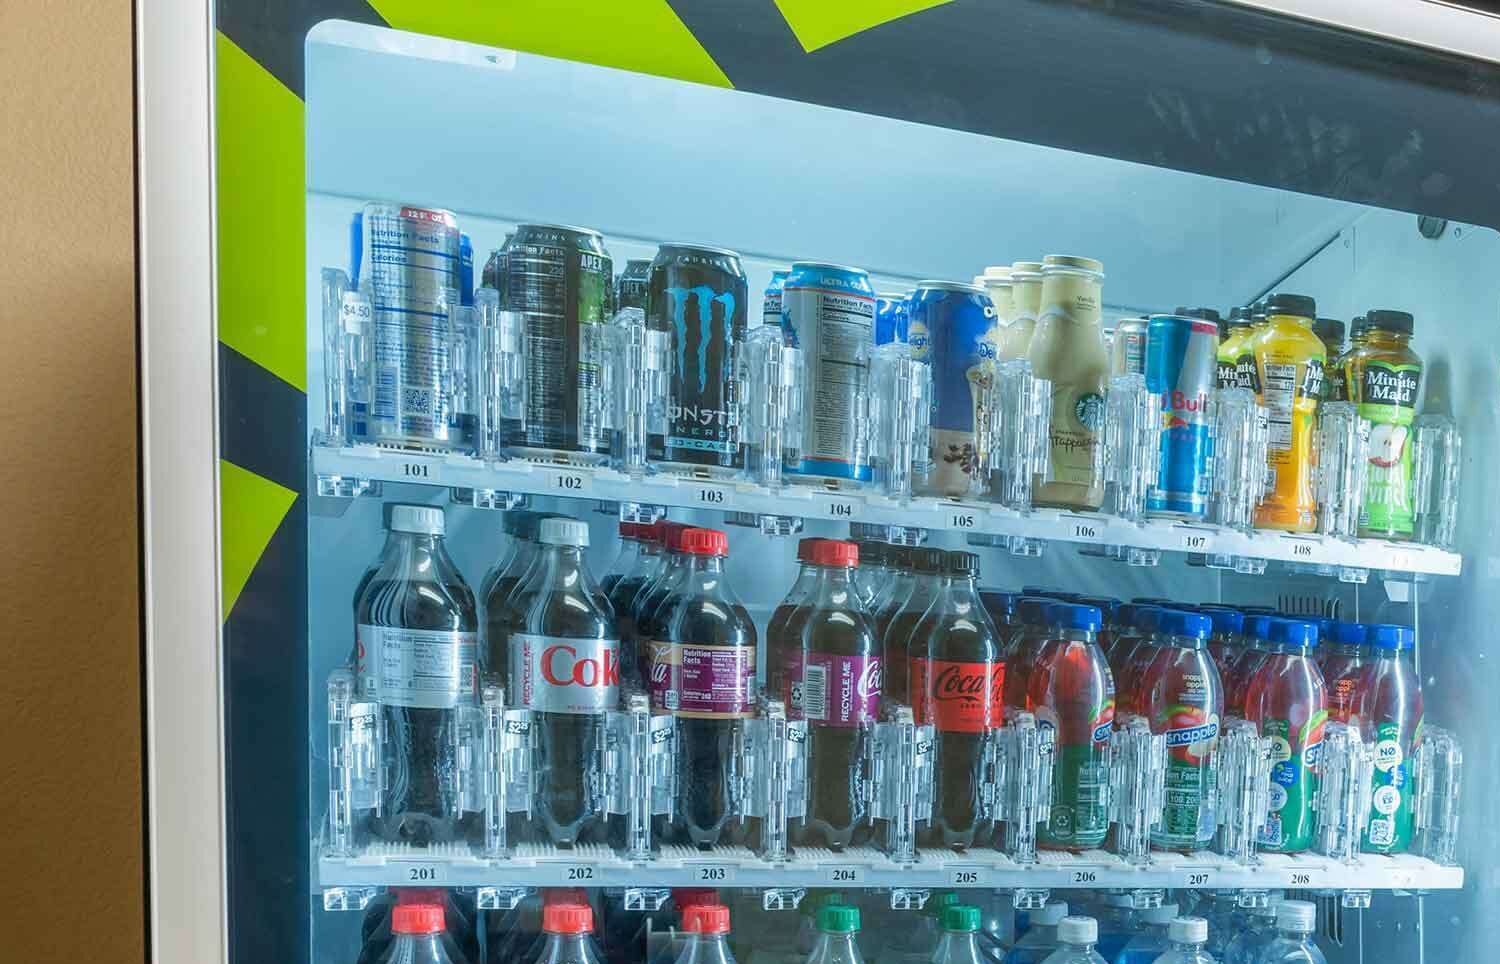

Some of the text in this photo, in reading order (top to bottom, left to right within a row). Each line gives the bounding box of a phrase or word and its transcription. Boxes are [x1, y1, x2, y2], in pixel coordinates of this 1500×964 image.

[822, 296, 858, 309] Nutrition
[343, 302, 370, 319] $4.50
[1367, 370, 1417, 390] Minute
[1372, 385, 1411, 402] Maid
[1174, 390, 1209, 414] Bull
[404, 463, 429, 478] 101
[557, 475, 583, 490] 102
[699, 489, 724, 503] 103
[829, 502, 852, 517] 104
[952, 515, 974, 528] 105
[1075, 525, 1095, 538] 106
[1186, 536, 1206, 548] 107
[1293, 544, 1312, 556] 108
[683, 649, 713, 658] Nutrition
[683, 656, 702, 666] Facts
[841, 662, 852, 722] RECYCLE ME
[1166, 722, 1218, 747] snapple
[409, 866, 437, 882] 201
[567, 865, 594, 881] 202
[701, 866, 726, 881] 203
[832, 867, 858, 882] 204
[955, 870, 978, 884] 205
[1074, 869, 1096, 884] 206
[1188, 871, 1210, 886] 207
[1290, 871, 1310, 886] 208
